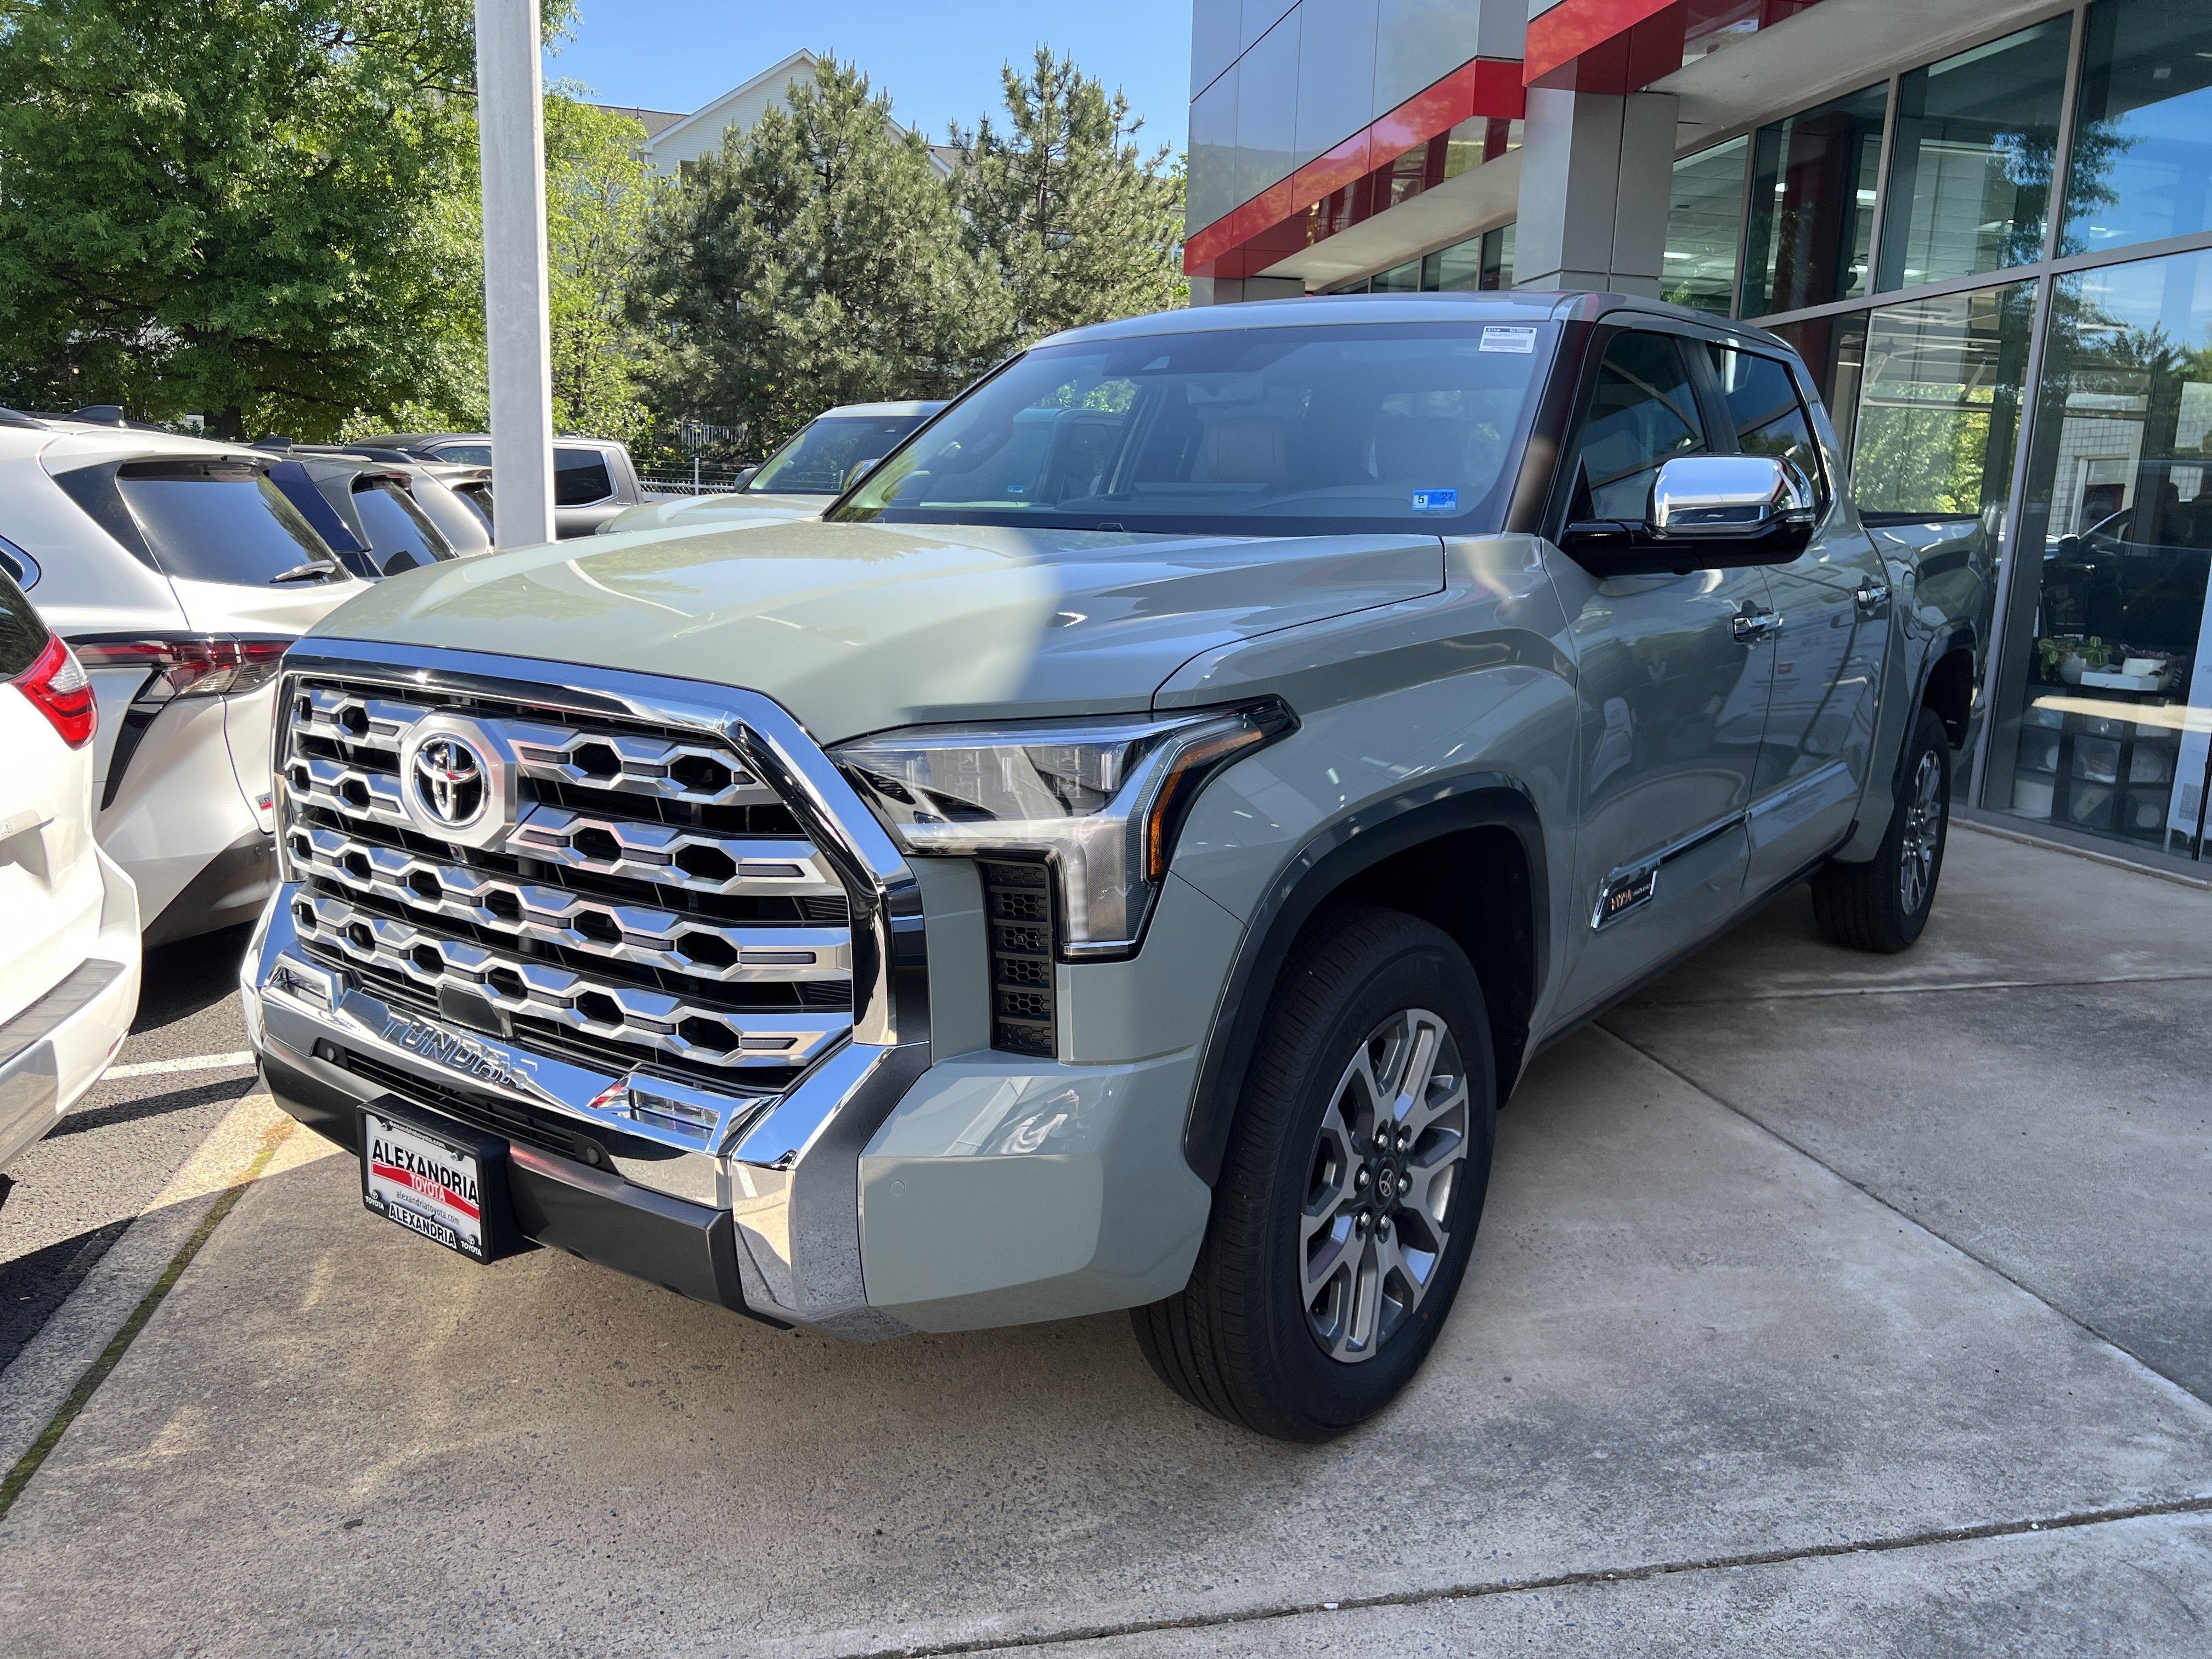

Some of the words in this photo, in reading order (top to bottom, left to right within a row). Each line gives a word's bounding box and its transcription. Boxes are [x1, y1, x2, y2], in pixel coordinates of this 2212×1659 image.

[1418, 495, 1425, 504] 5
[380, 1012, 538, 1091] TUNDRA
[372, 1138, 479, 1205] ALEXANDRIA
[365, 1195, 385, 1210] TOYOTA
[409, 1173, 446, 1204] TOYOTA
[396, 1190, 460, 1226] alexandriatoyota.com
[390, 1204, 456, 1248] ALEXANDRIA
[460, 1240, 482, 1257] TOYOTA
